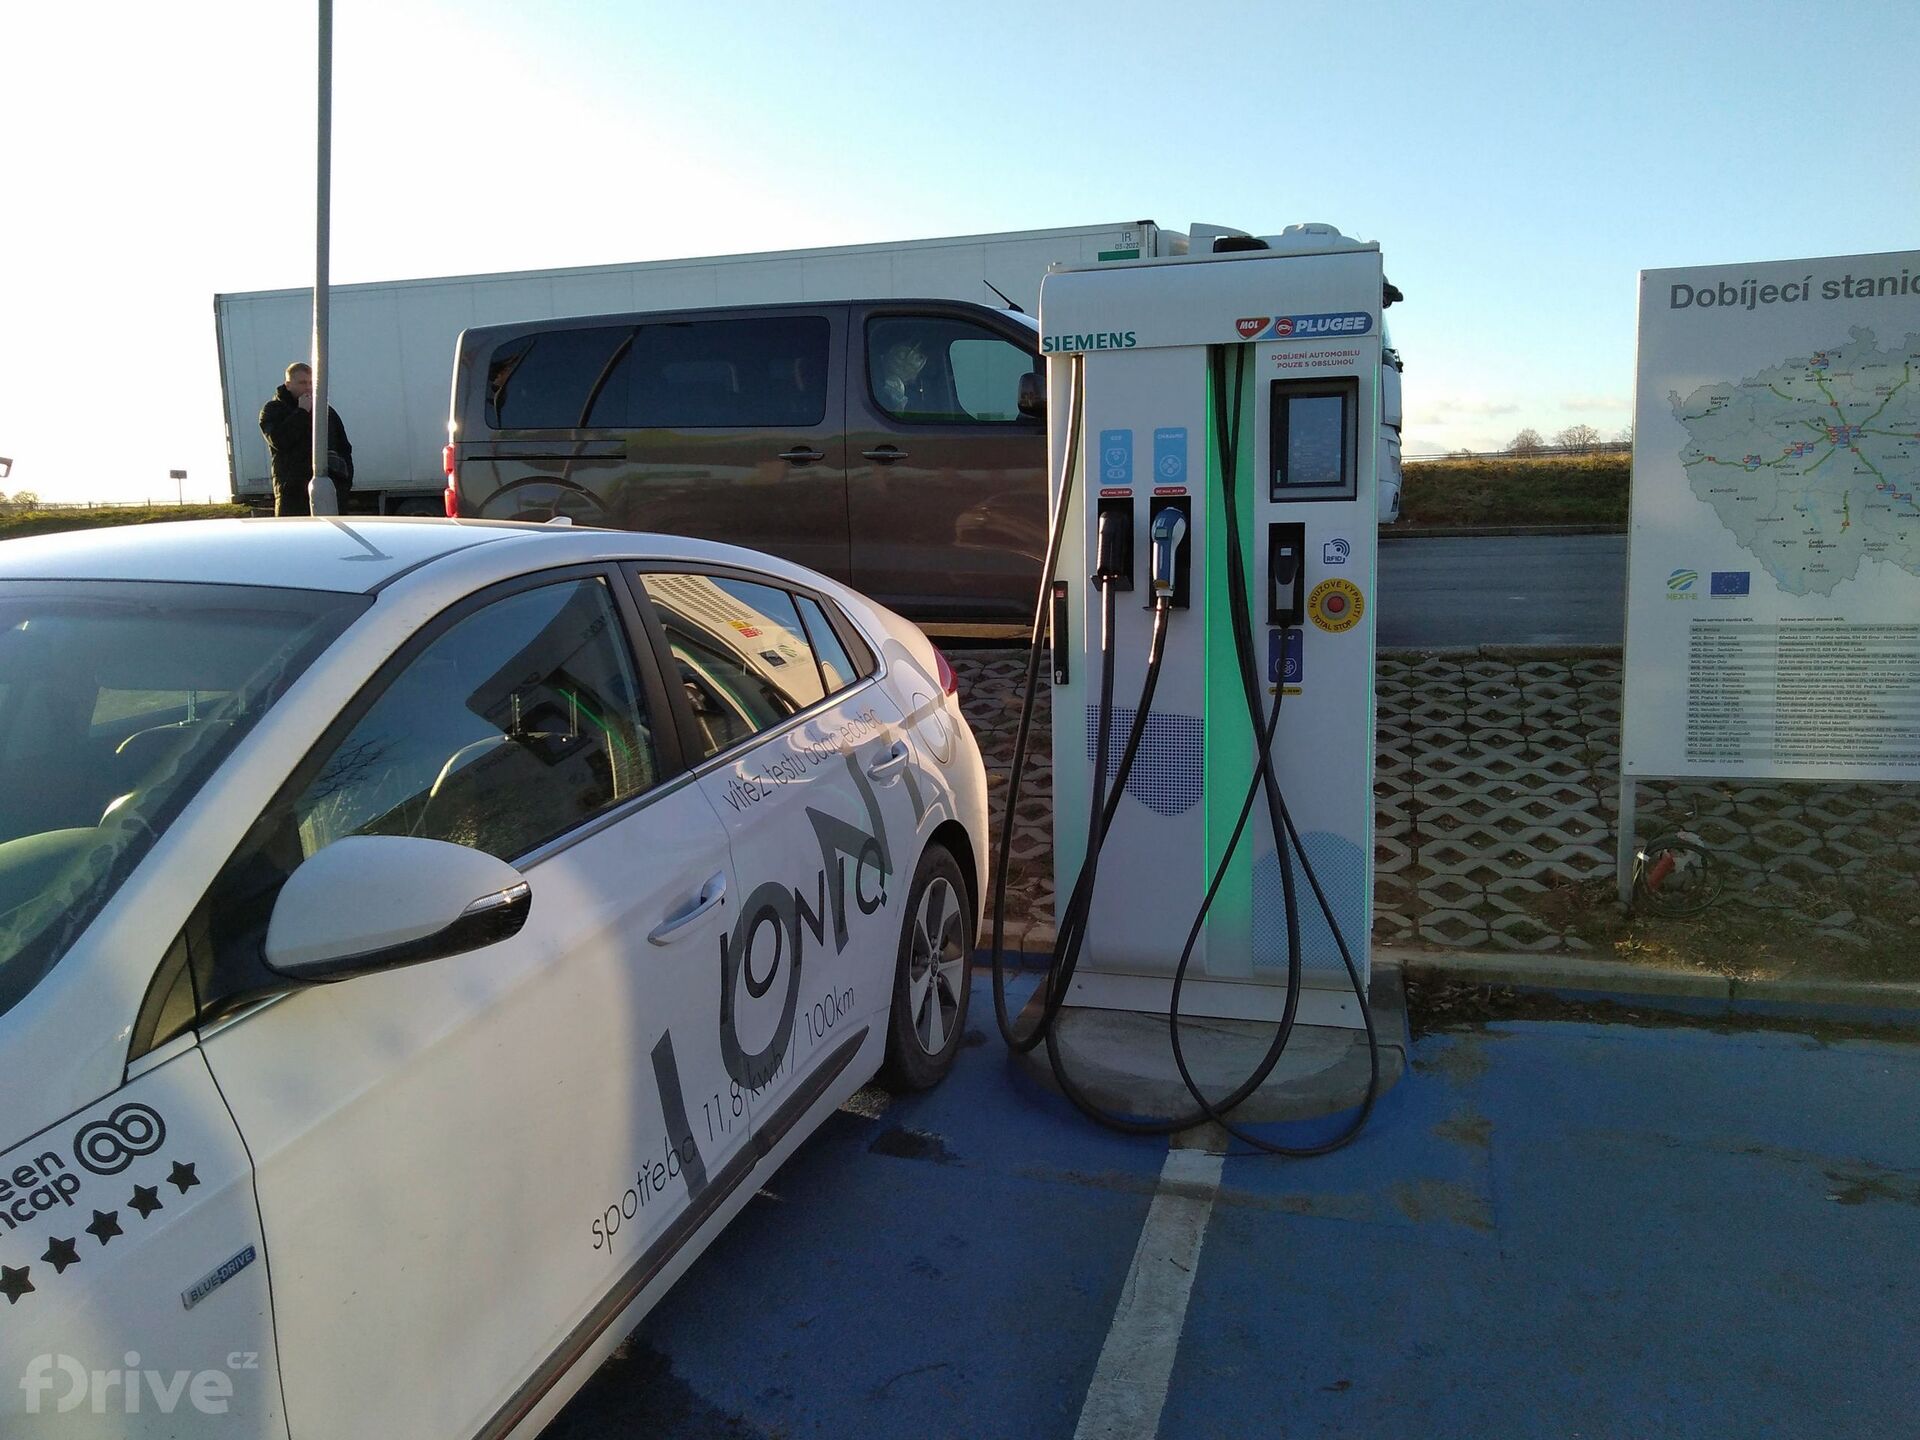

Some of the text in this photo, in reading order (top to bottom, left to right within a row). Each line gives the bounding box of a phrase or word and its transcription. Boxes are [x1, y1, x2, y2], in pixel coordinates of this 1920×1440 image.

[1670, 275, 1812, 310] Dobíjecí
[1240, 321, 1259, 330] MOL
[1295, 317, 1366, 333] PLUGEE
[1042, 331, 1137, 352] SIEMENS
[1277, 361, 1303, 369] POUZE
[1312, 614, 1352, 631] TOTAL STOP
[723, 774, 772, 813] vítěz
[765, 753, 807, 790] testu
[803, 733, 843, 766] adac
[591, 1135, 697, 1254] spotřeba
[703, 1077, 745, 1142] 11,8
[0, 1151, 66, 1202] een
